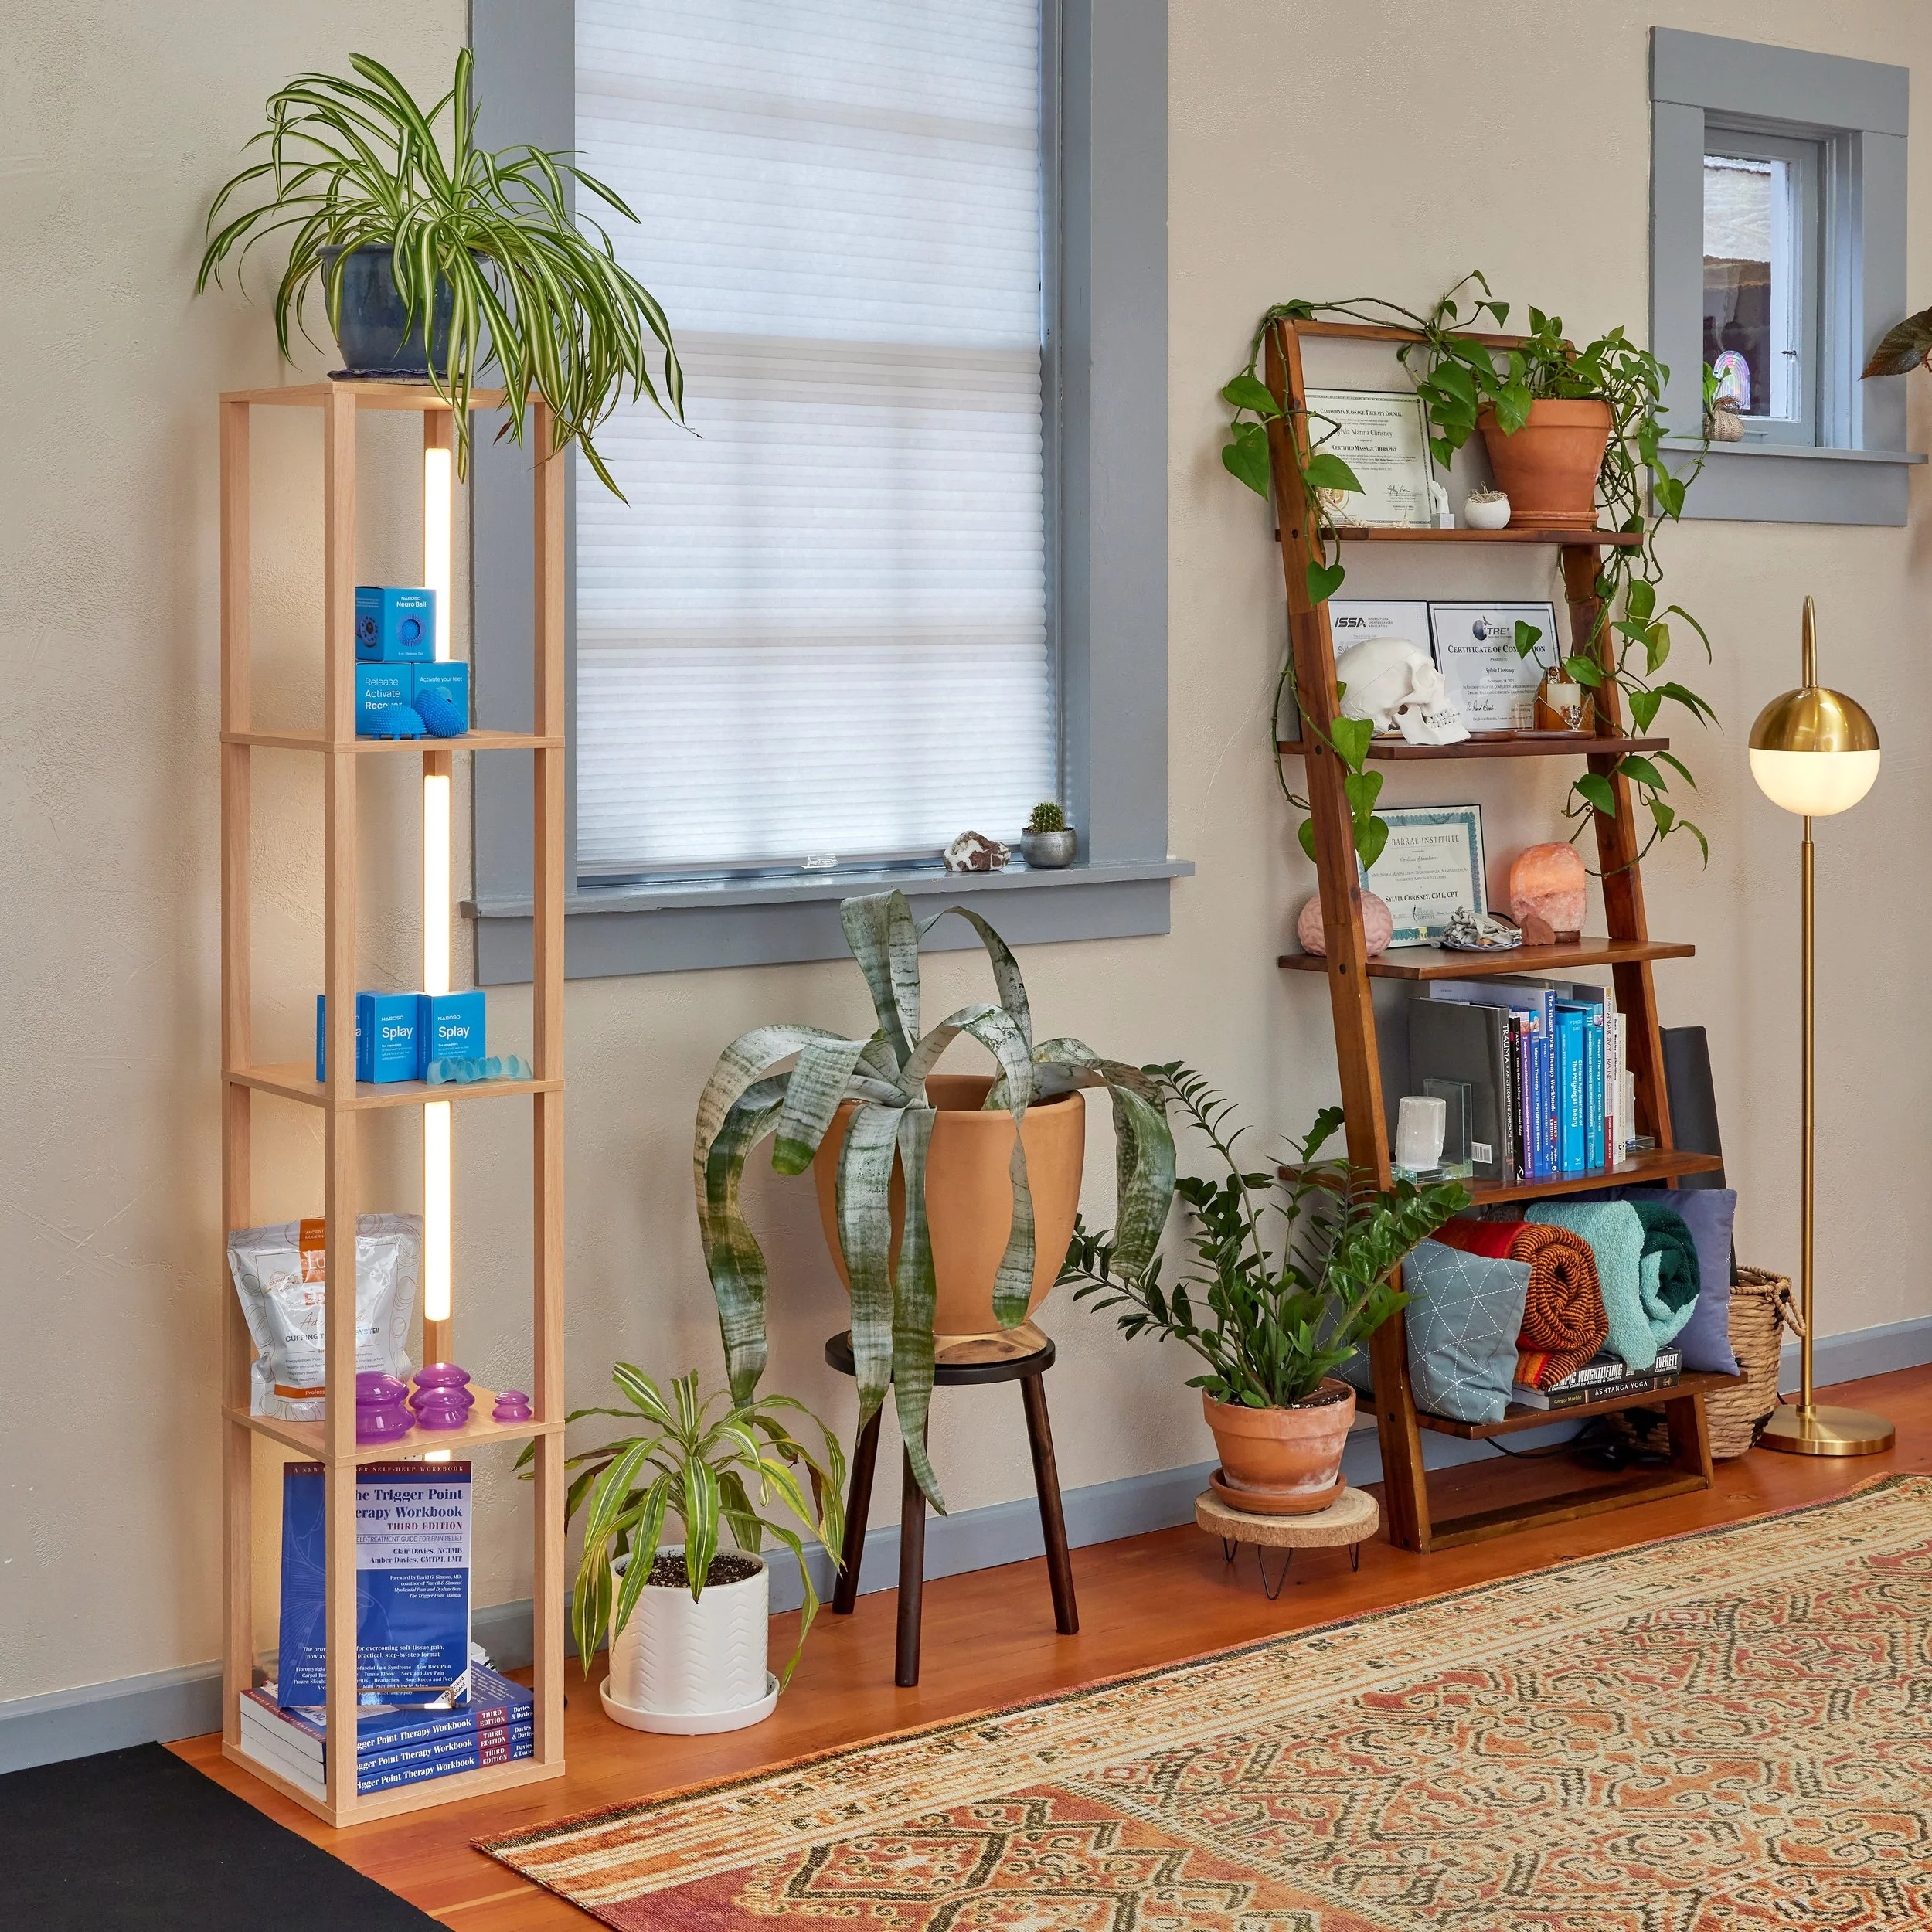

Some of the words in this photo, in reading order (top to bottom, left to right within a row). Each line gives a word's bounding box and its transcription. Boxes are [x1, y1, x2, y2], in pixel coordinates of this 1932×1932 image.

[1335, 617, 1366, 627] ISSA
[1448, 645, 1491, 653] CERTIFICATE
[365, 678, 398, 686] Release
[1392, 837, 1418, 846] BARRAL
[1422, 835, 1459, 844] INSTITUTE
[382, 1026, 413, 1041] Splay
[439, 1025, 470, 1040] Splay
[1656, 1354, 1678, 1368] EVERETT
[1578, 1363, 1623, 1383] WEIGHTLIFTING
[1595, 1384, 1628, 1396] ASHTANGA
[356, 1490, 370, 1500] he
[374, 1489, 424, 1503] Trigger
[428, 1489, 463, 1500] Point
[356, 1509, 391, 1520] erapy
[396, 1506, 463, 1518] Workbook
[482, 1709, 502, 1718] THIRD
[480, 1716, 505, 1726] EDITION
[357, 1739, 375, 1750] gger
[377, 1734, 397, 1745] Point
[399, 1727, 431, 1741] Therapy
[432, 1718, 471, 1733] Workbook
[483, 1730, 503, 1739] THIRD
[481, 1737, 506, 1747] EDITION
[357, 1760, 376, 1772] gger
[378, 1755, 398, 1766] Point
[401, 1748, 432, 1761] Therapy
[434, 1739, 472, 1753] Workbook
[485, 1748, 505, 1757] THIRD
[483, 1754, 507, 1765] EDITION
[357, 1779, 379, 1790] igger
[381, 1773, 401, 1784] Point
[403, 1767, 434, 1779] Therapy
[436, 1757, 474, 1772] Workbook
